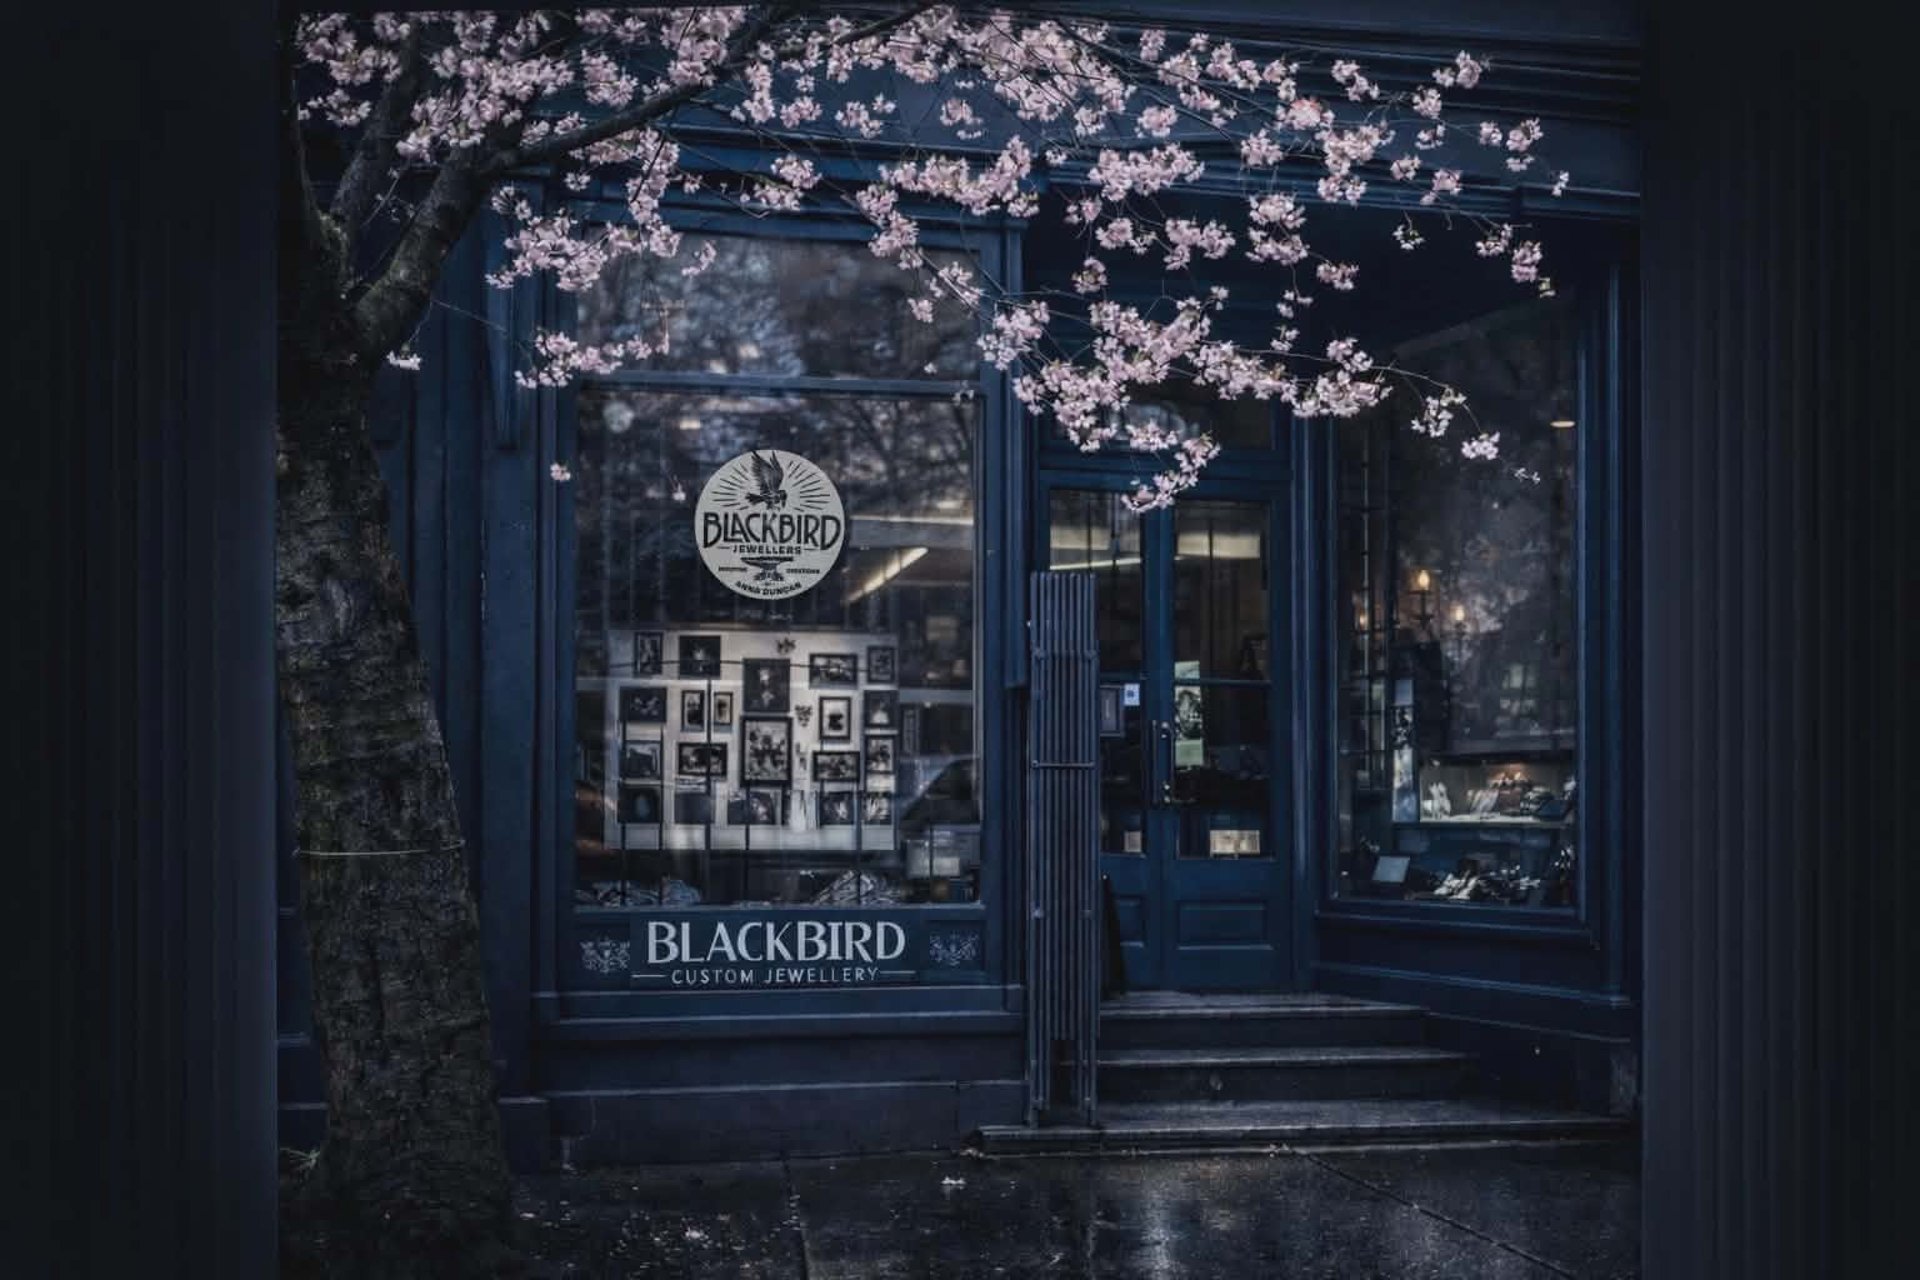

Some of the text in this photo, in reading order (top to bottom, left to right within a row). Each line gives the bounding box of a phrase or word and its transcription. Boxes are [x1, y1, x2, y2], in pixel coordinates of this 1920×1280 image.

[703, 511, 841, 551] BLACKBIRD
[732, 545, 801, 555] JEWELLERS
[763, 582, 802, 595] DUNCAN
[647, 920, 906, 963] BLACKBIRD
[672, 967, 879, 985] CUSTOM JEWELLERY
